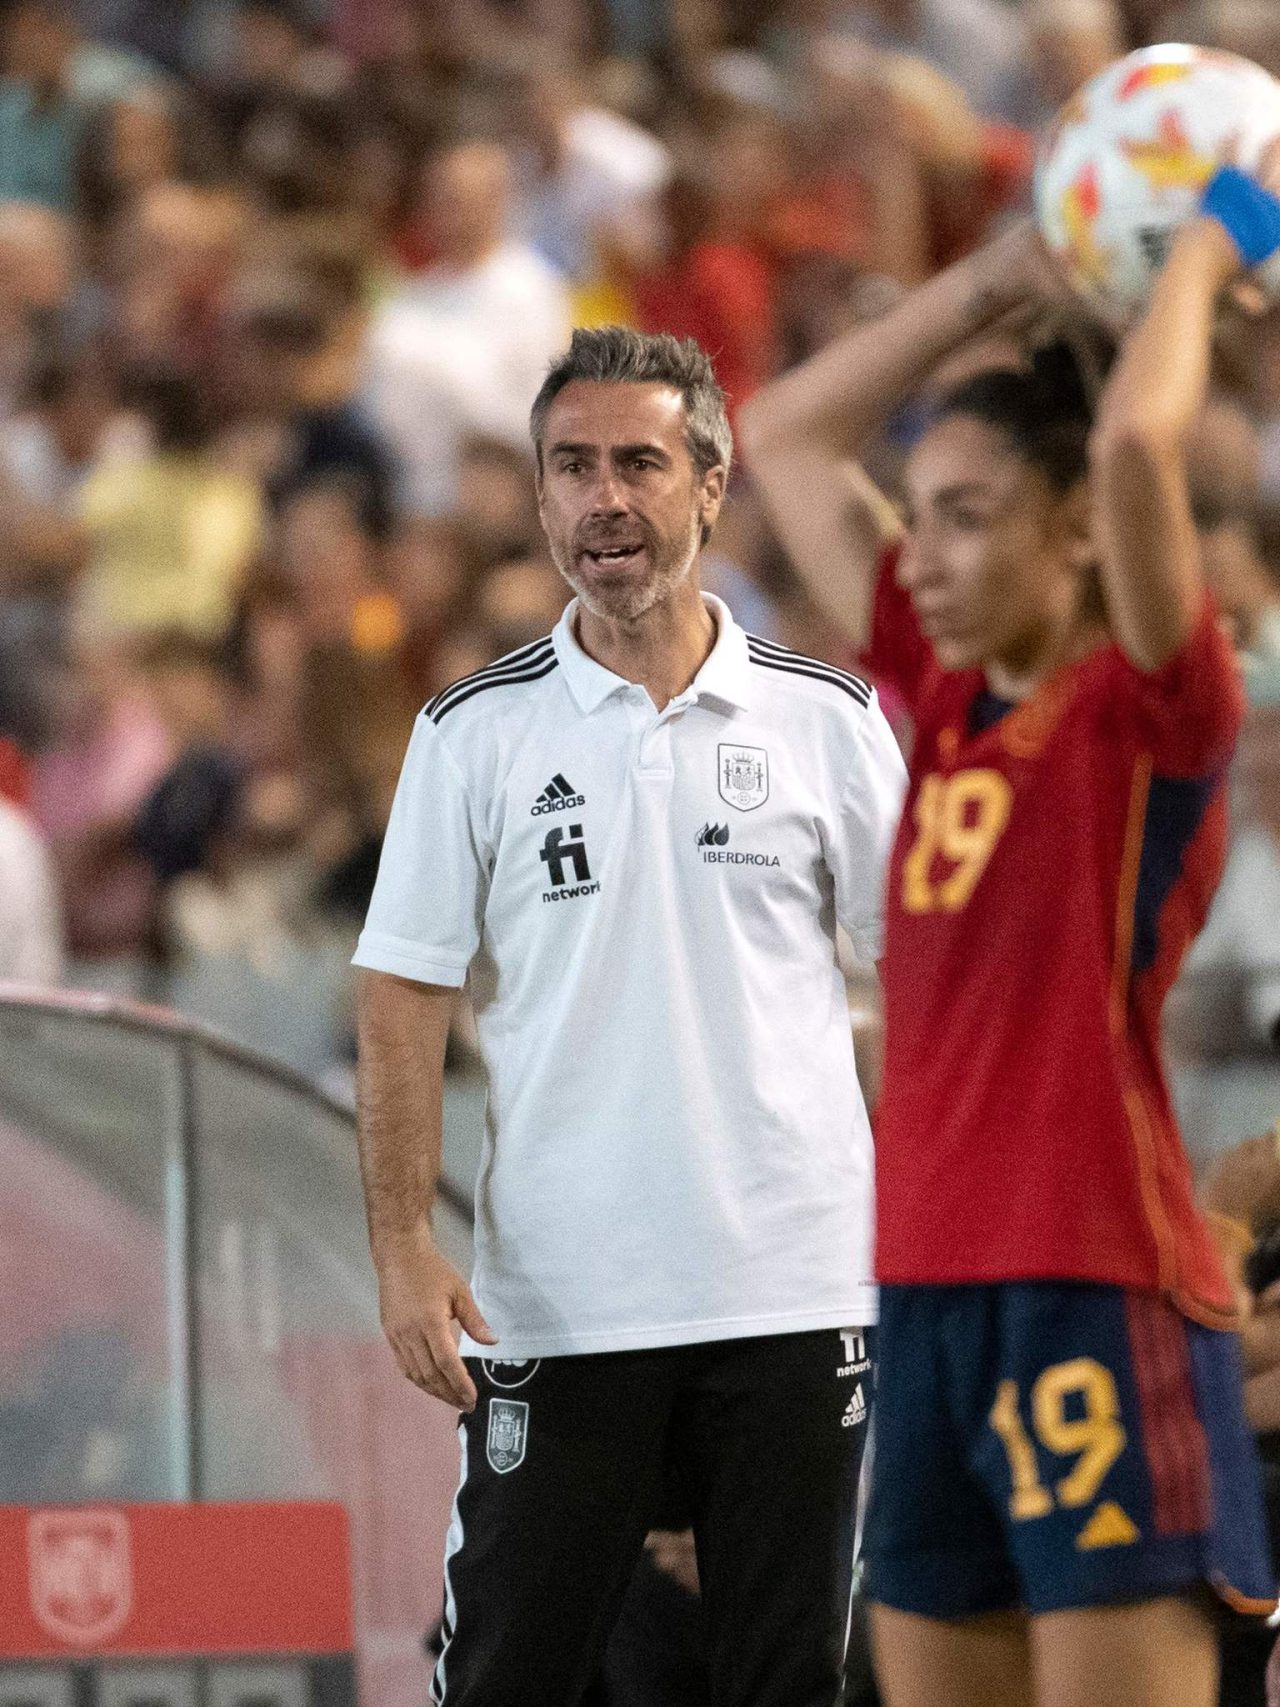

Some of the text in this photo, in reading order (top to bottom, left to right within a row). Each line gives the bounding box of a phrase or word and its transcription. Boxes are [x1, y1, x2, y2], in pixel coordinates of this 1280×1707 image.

[530, 794, 586, 817] adidas
[539, 823, 591, 886] fi
[703, 851, 781, 867] IBERDROLA
[904, 767, 1015, 915] 19
[988, 1356, 1127, 1522] 19
